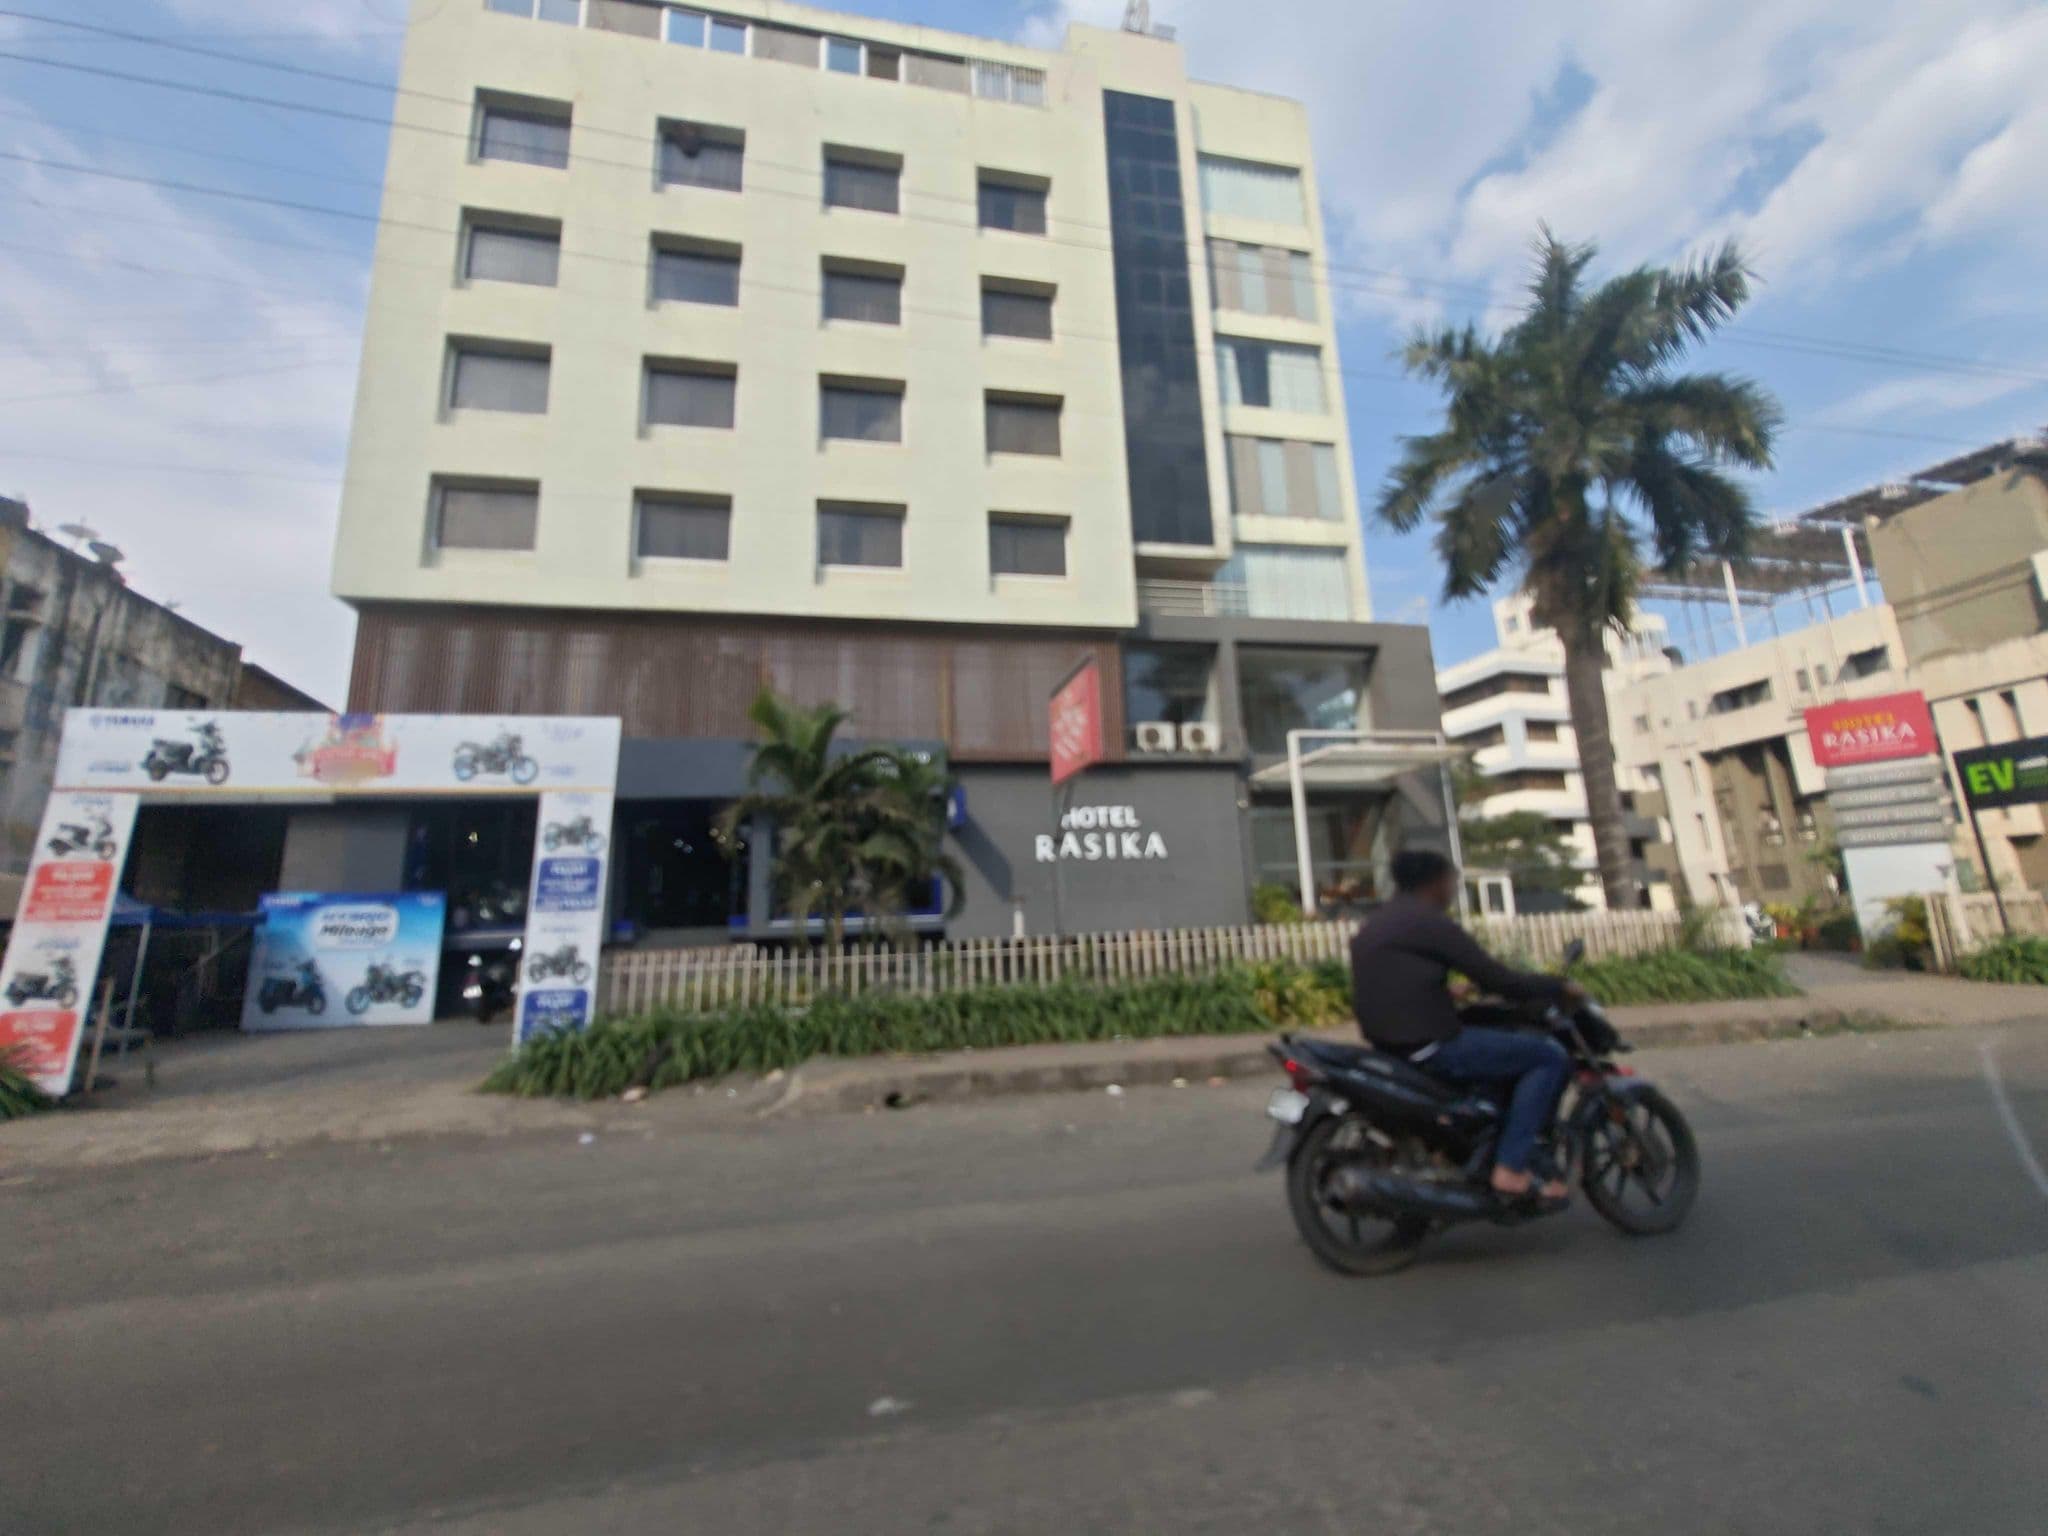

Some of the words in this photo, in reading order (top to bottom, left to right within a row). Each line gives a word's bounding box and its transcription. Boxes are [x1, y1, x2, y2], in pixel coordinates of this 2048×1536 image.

[1822, 722, 1917, 748] RASIKA
[1966, 758, 2015, 795] EV
[1062, 806, 1141, 829] HOTEL
[1035, 832, 1168, 862] RASIKA
